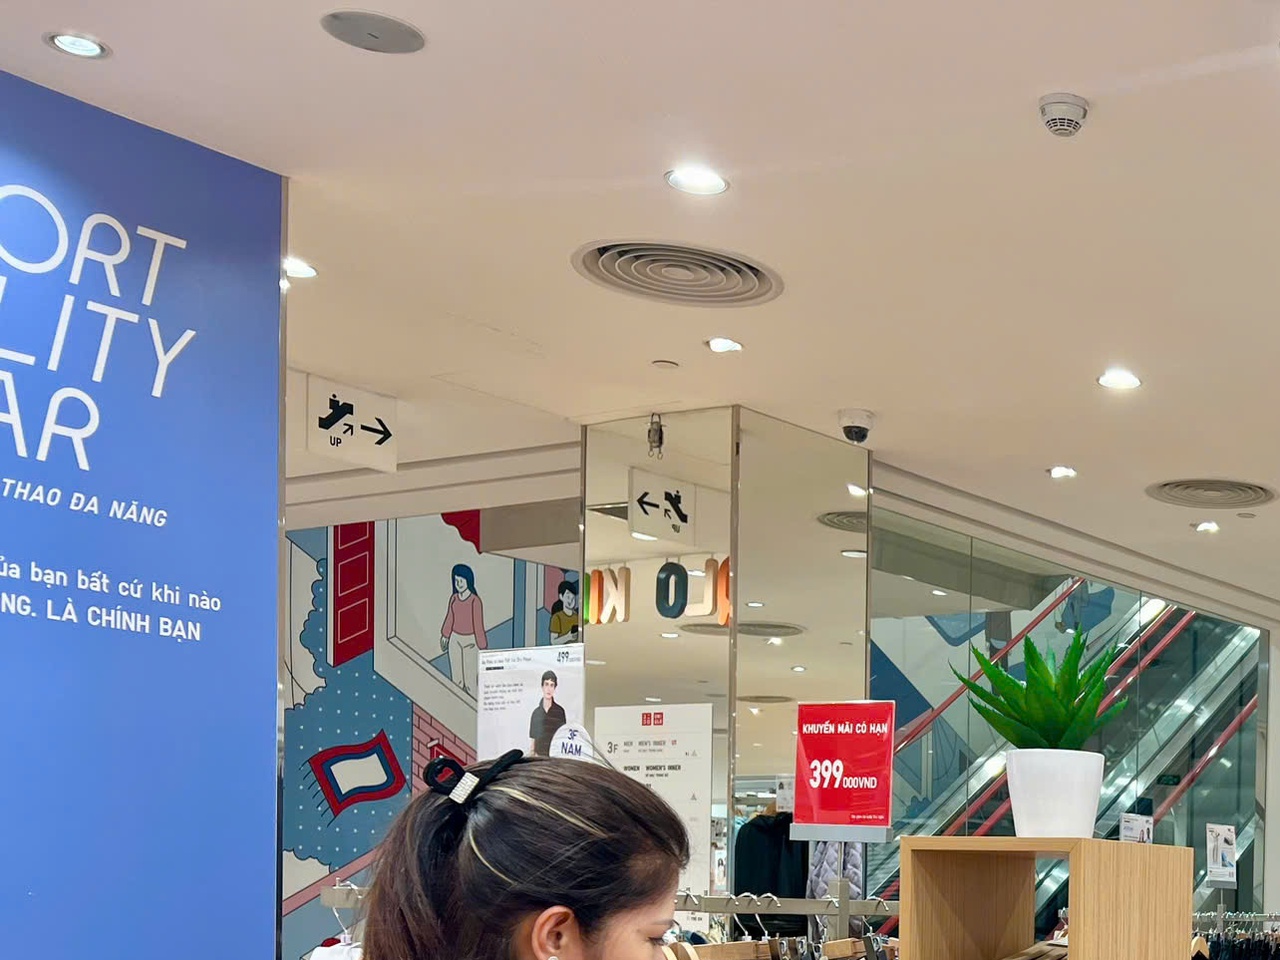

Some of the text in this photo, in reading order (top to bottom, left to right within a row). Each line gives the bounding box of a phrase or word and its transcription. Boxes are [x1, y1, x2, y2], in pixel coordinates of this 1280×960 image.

[330, 435, 342, 447] UP
[2, 478, 168, 527] THAO ĐA NĂNG
[30, 561, 68, 588] bạn
[77, 569, 110, 593] bất
[118, 578, 144, 599] cứ
[152, 582, 180, 605] khi
[188, 591, 221, 611] nào
[1, 592, 201, 642] NG. LÀ CHÍNH BẠN
[567, 729, 578, 740] 3F
[802, 720, 888, 736] KHUYẾN MÃI CÓ HẠN
[561, 742, 582, 757] NAM
[607, 741, 619, 754] 3F
